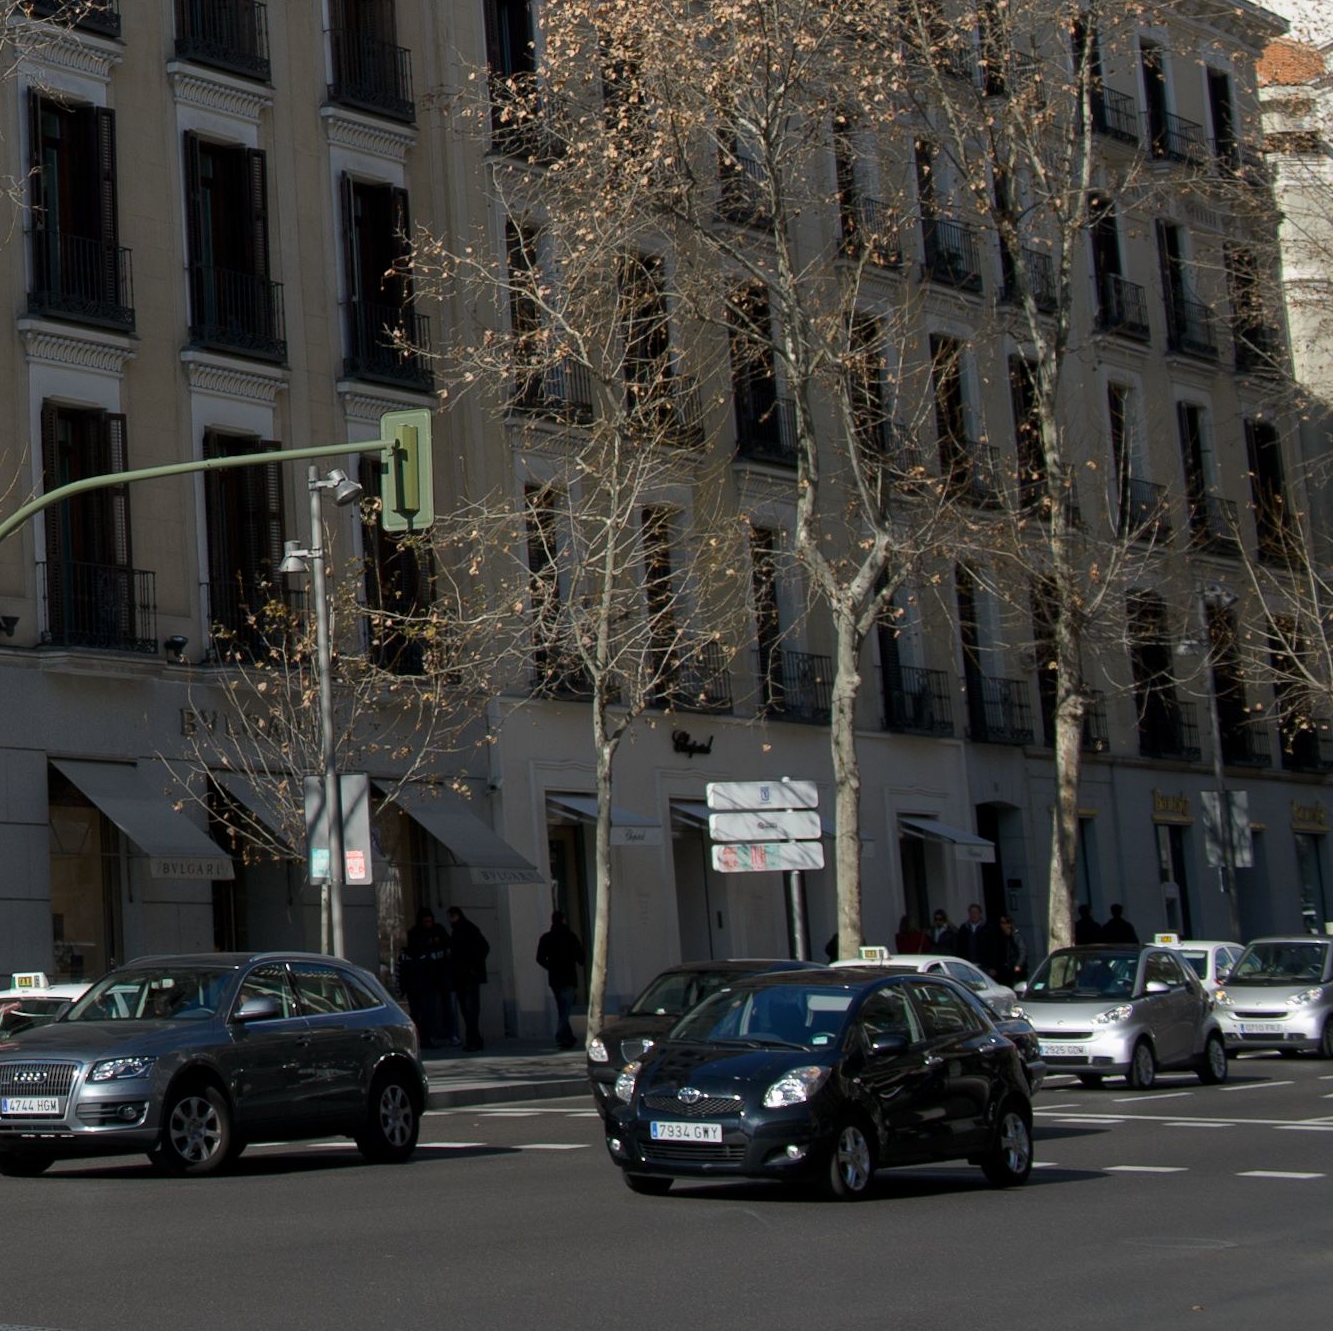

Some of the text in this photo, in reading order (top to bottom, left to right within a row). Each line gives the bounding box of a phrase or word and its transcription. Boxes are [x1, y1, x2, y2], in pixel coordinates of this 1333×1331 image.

[180, 708, 317, 744] BVLGA
[163, 863, 220, 876] BVLGARI
[10, 1100, 56, 1111] 4744 HGM
[659, 1125, 718, 1140] 7934 GWY
